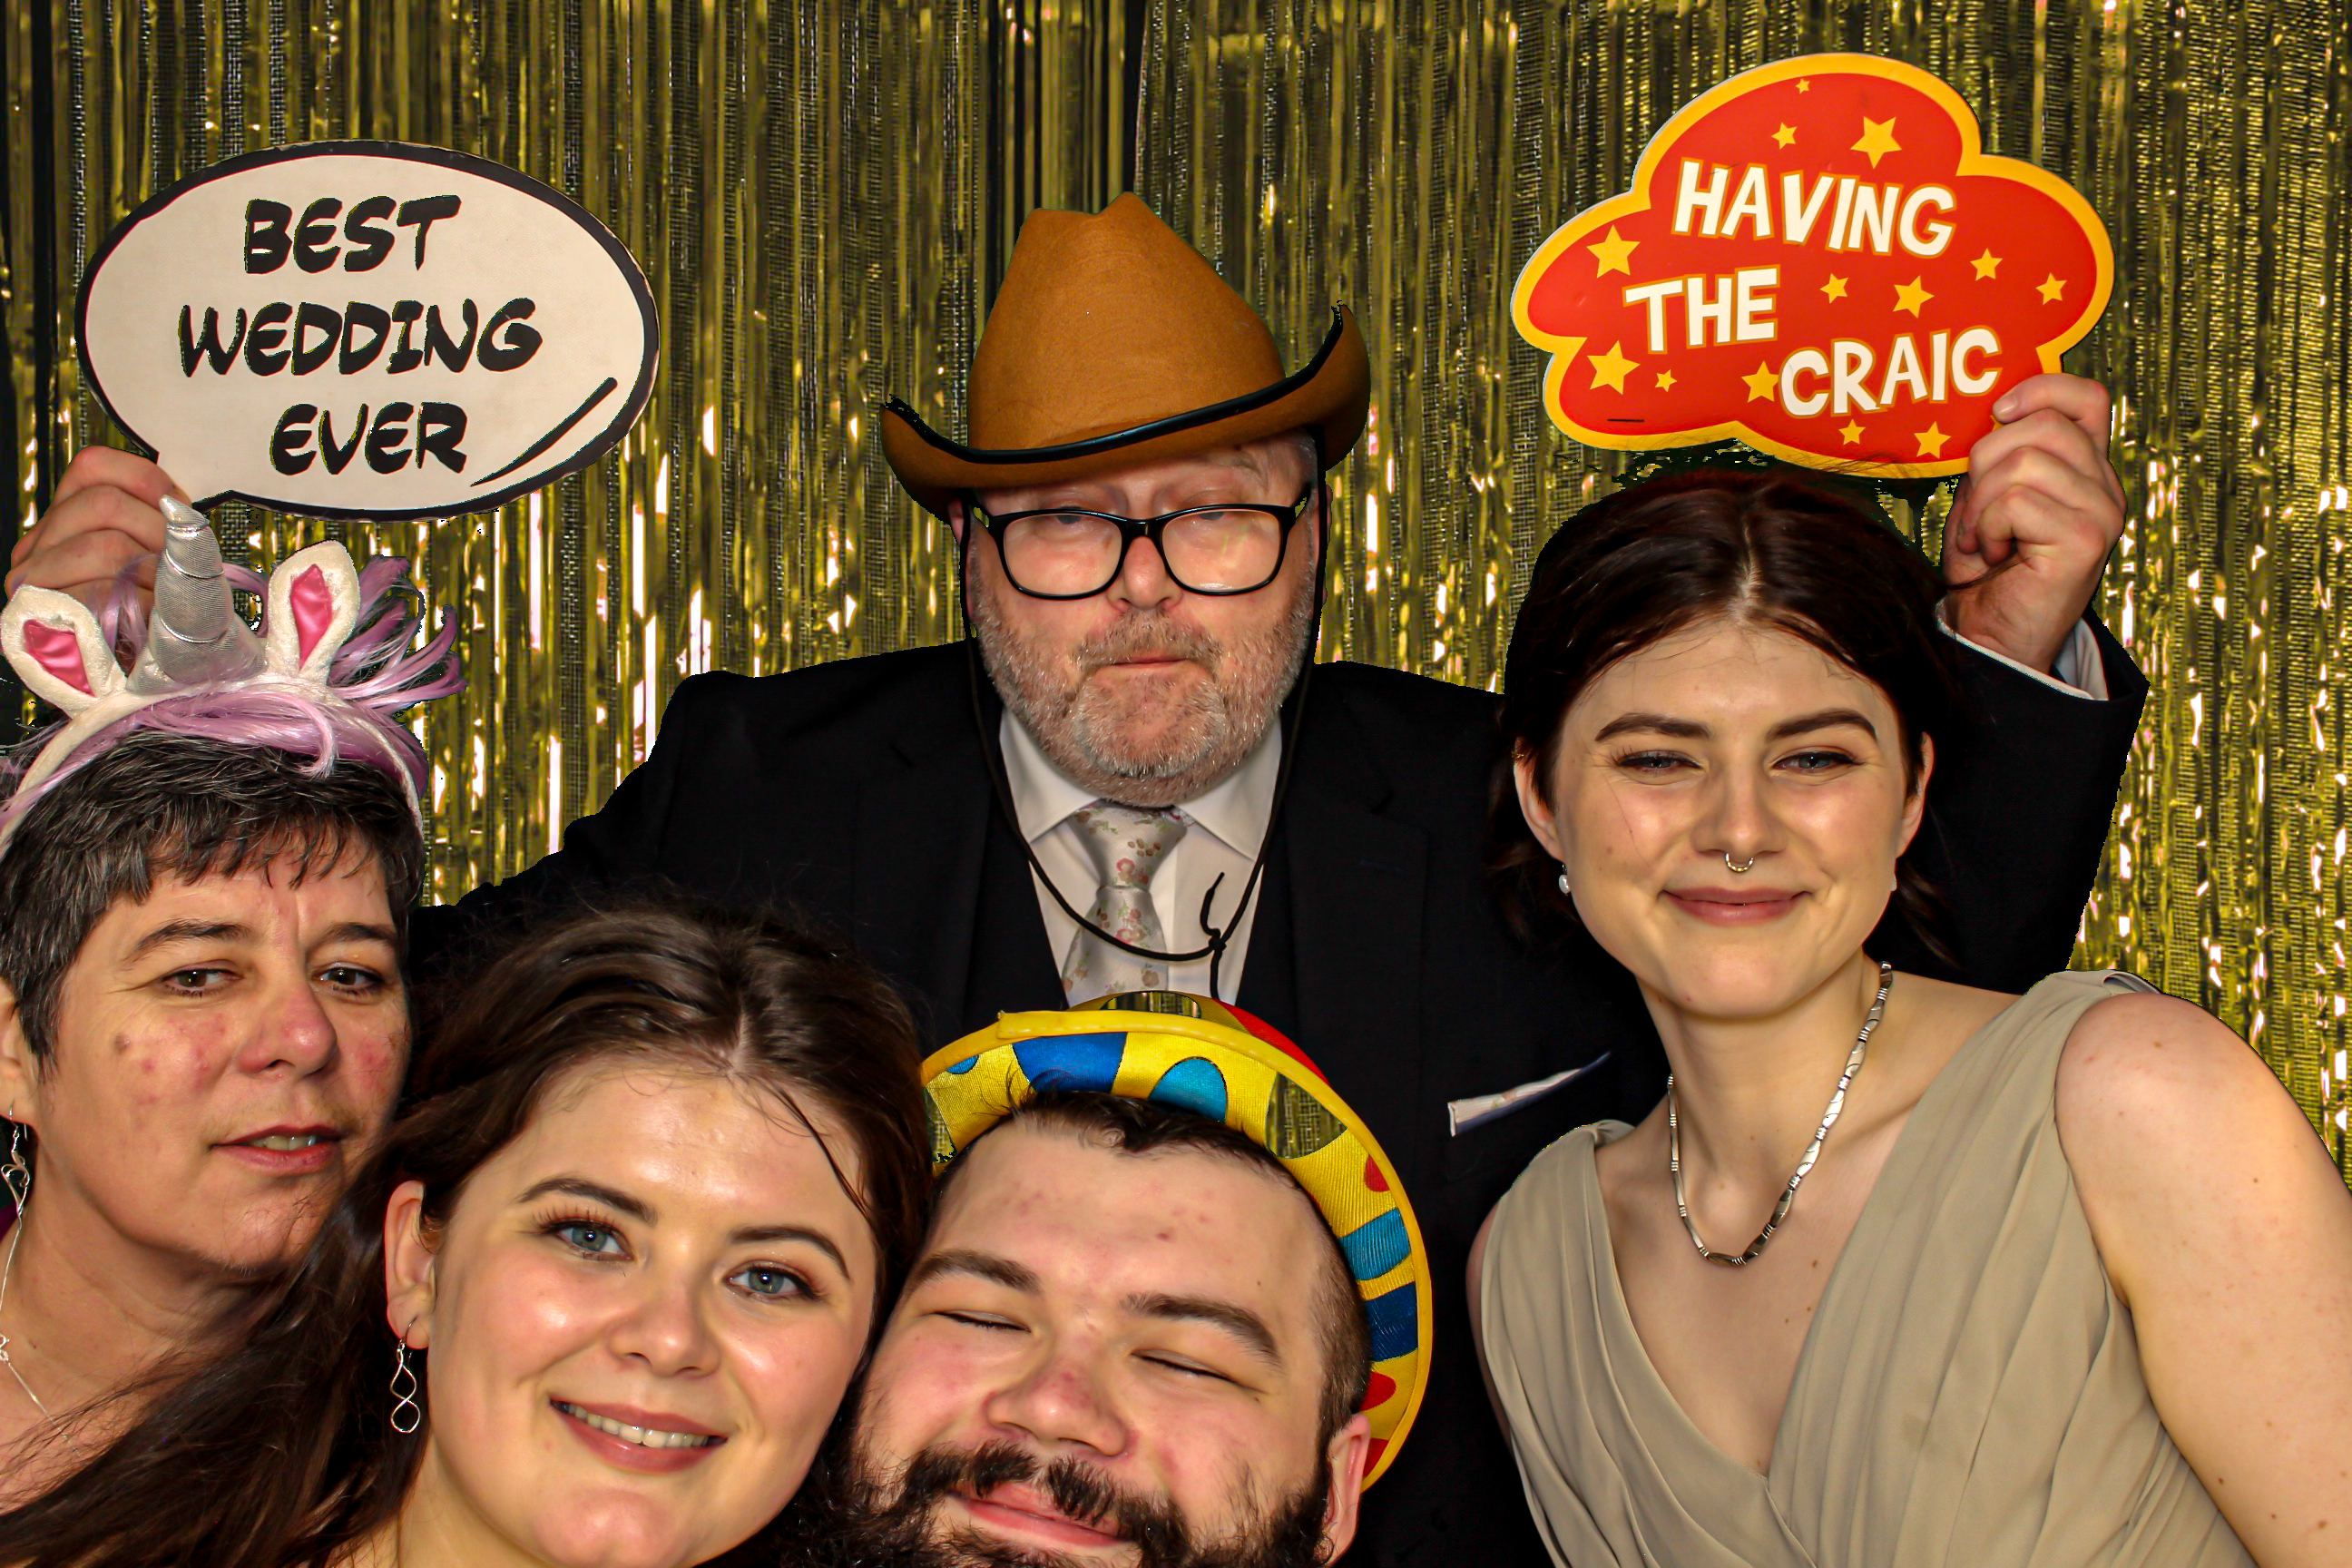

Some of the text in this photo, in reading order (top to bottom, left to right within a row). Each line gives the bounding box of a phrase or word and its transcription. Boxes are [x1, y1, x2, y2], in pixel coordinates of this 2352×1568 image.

[245, 195, 461, 274] BEST
[1672, 159, 1955, 257] HAVING
[179, 298, 544, 377] WEDDING
[1623, 267, 1779, 352] THE
[1779, 327, 1999, 417] CRAIC
[270, 401, 468, 475] EVER
